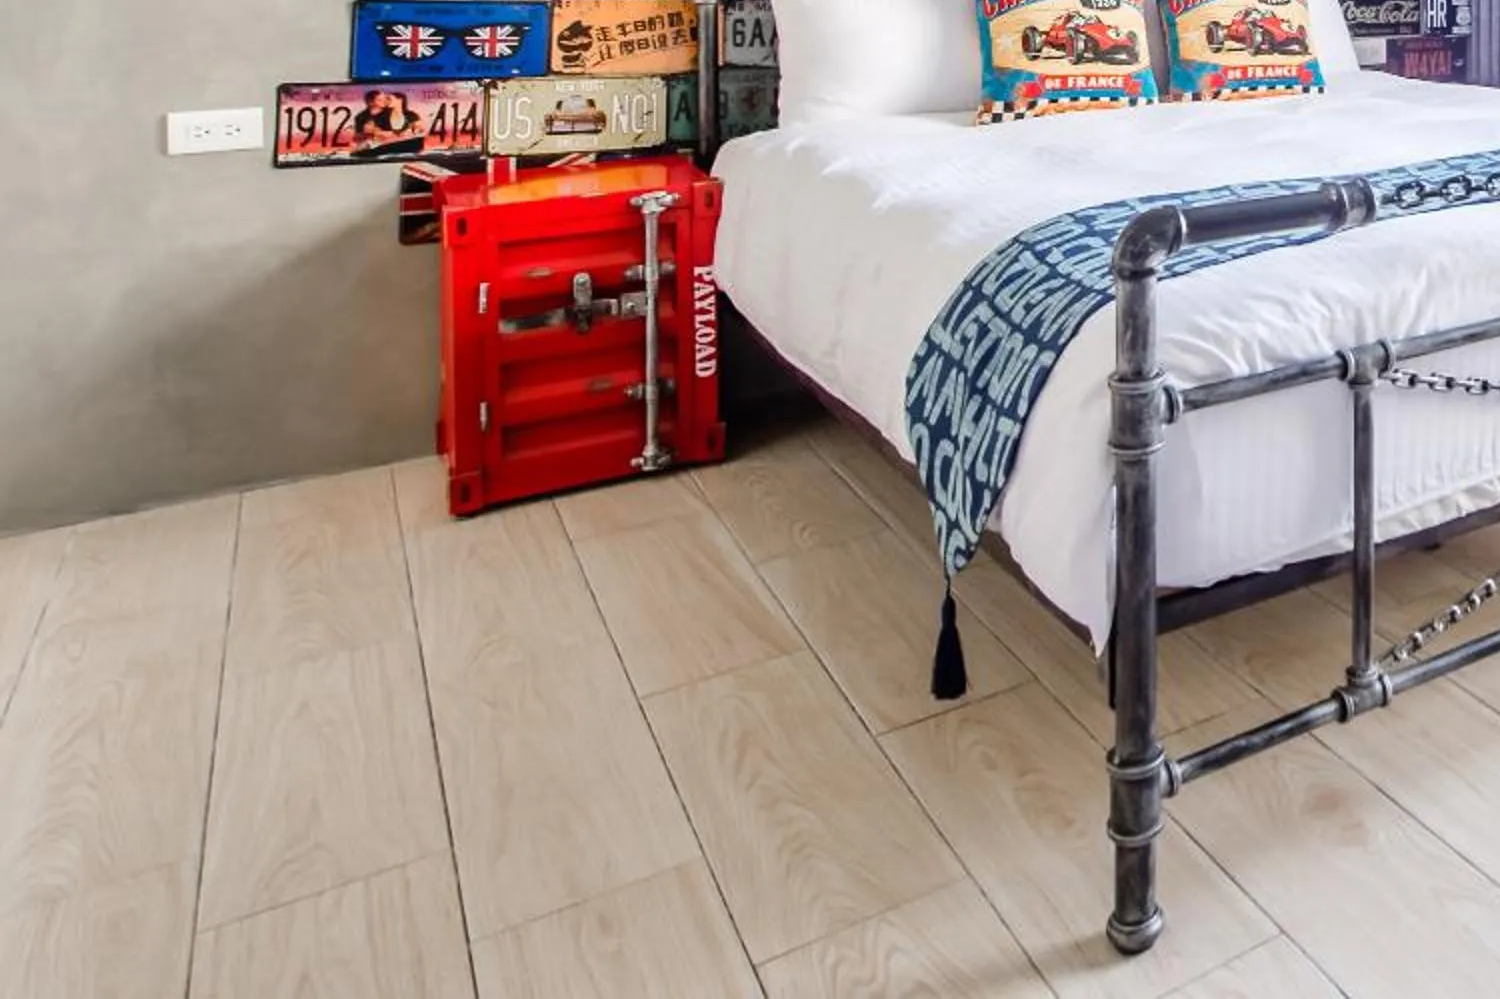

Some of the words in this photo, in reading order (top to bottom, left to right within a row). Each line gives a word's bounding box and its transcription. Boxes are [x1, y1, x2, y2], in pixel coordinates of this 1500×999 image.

[1067, 74, 1124, 89] FRANCE
[1247, 65, 1298, 78] FRANCE
[283, 105, 352, 150] 1912
[428, 102, 478, 144] 414
[493, 96, 532, 140] US
[693, 264, 718, 378] PAYLOAD
